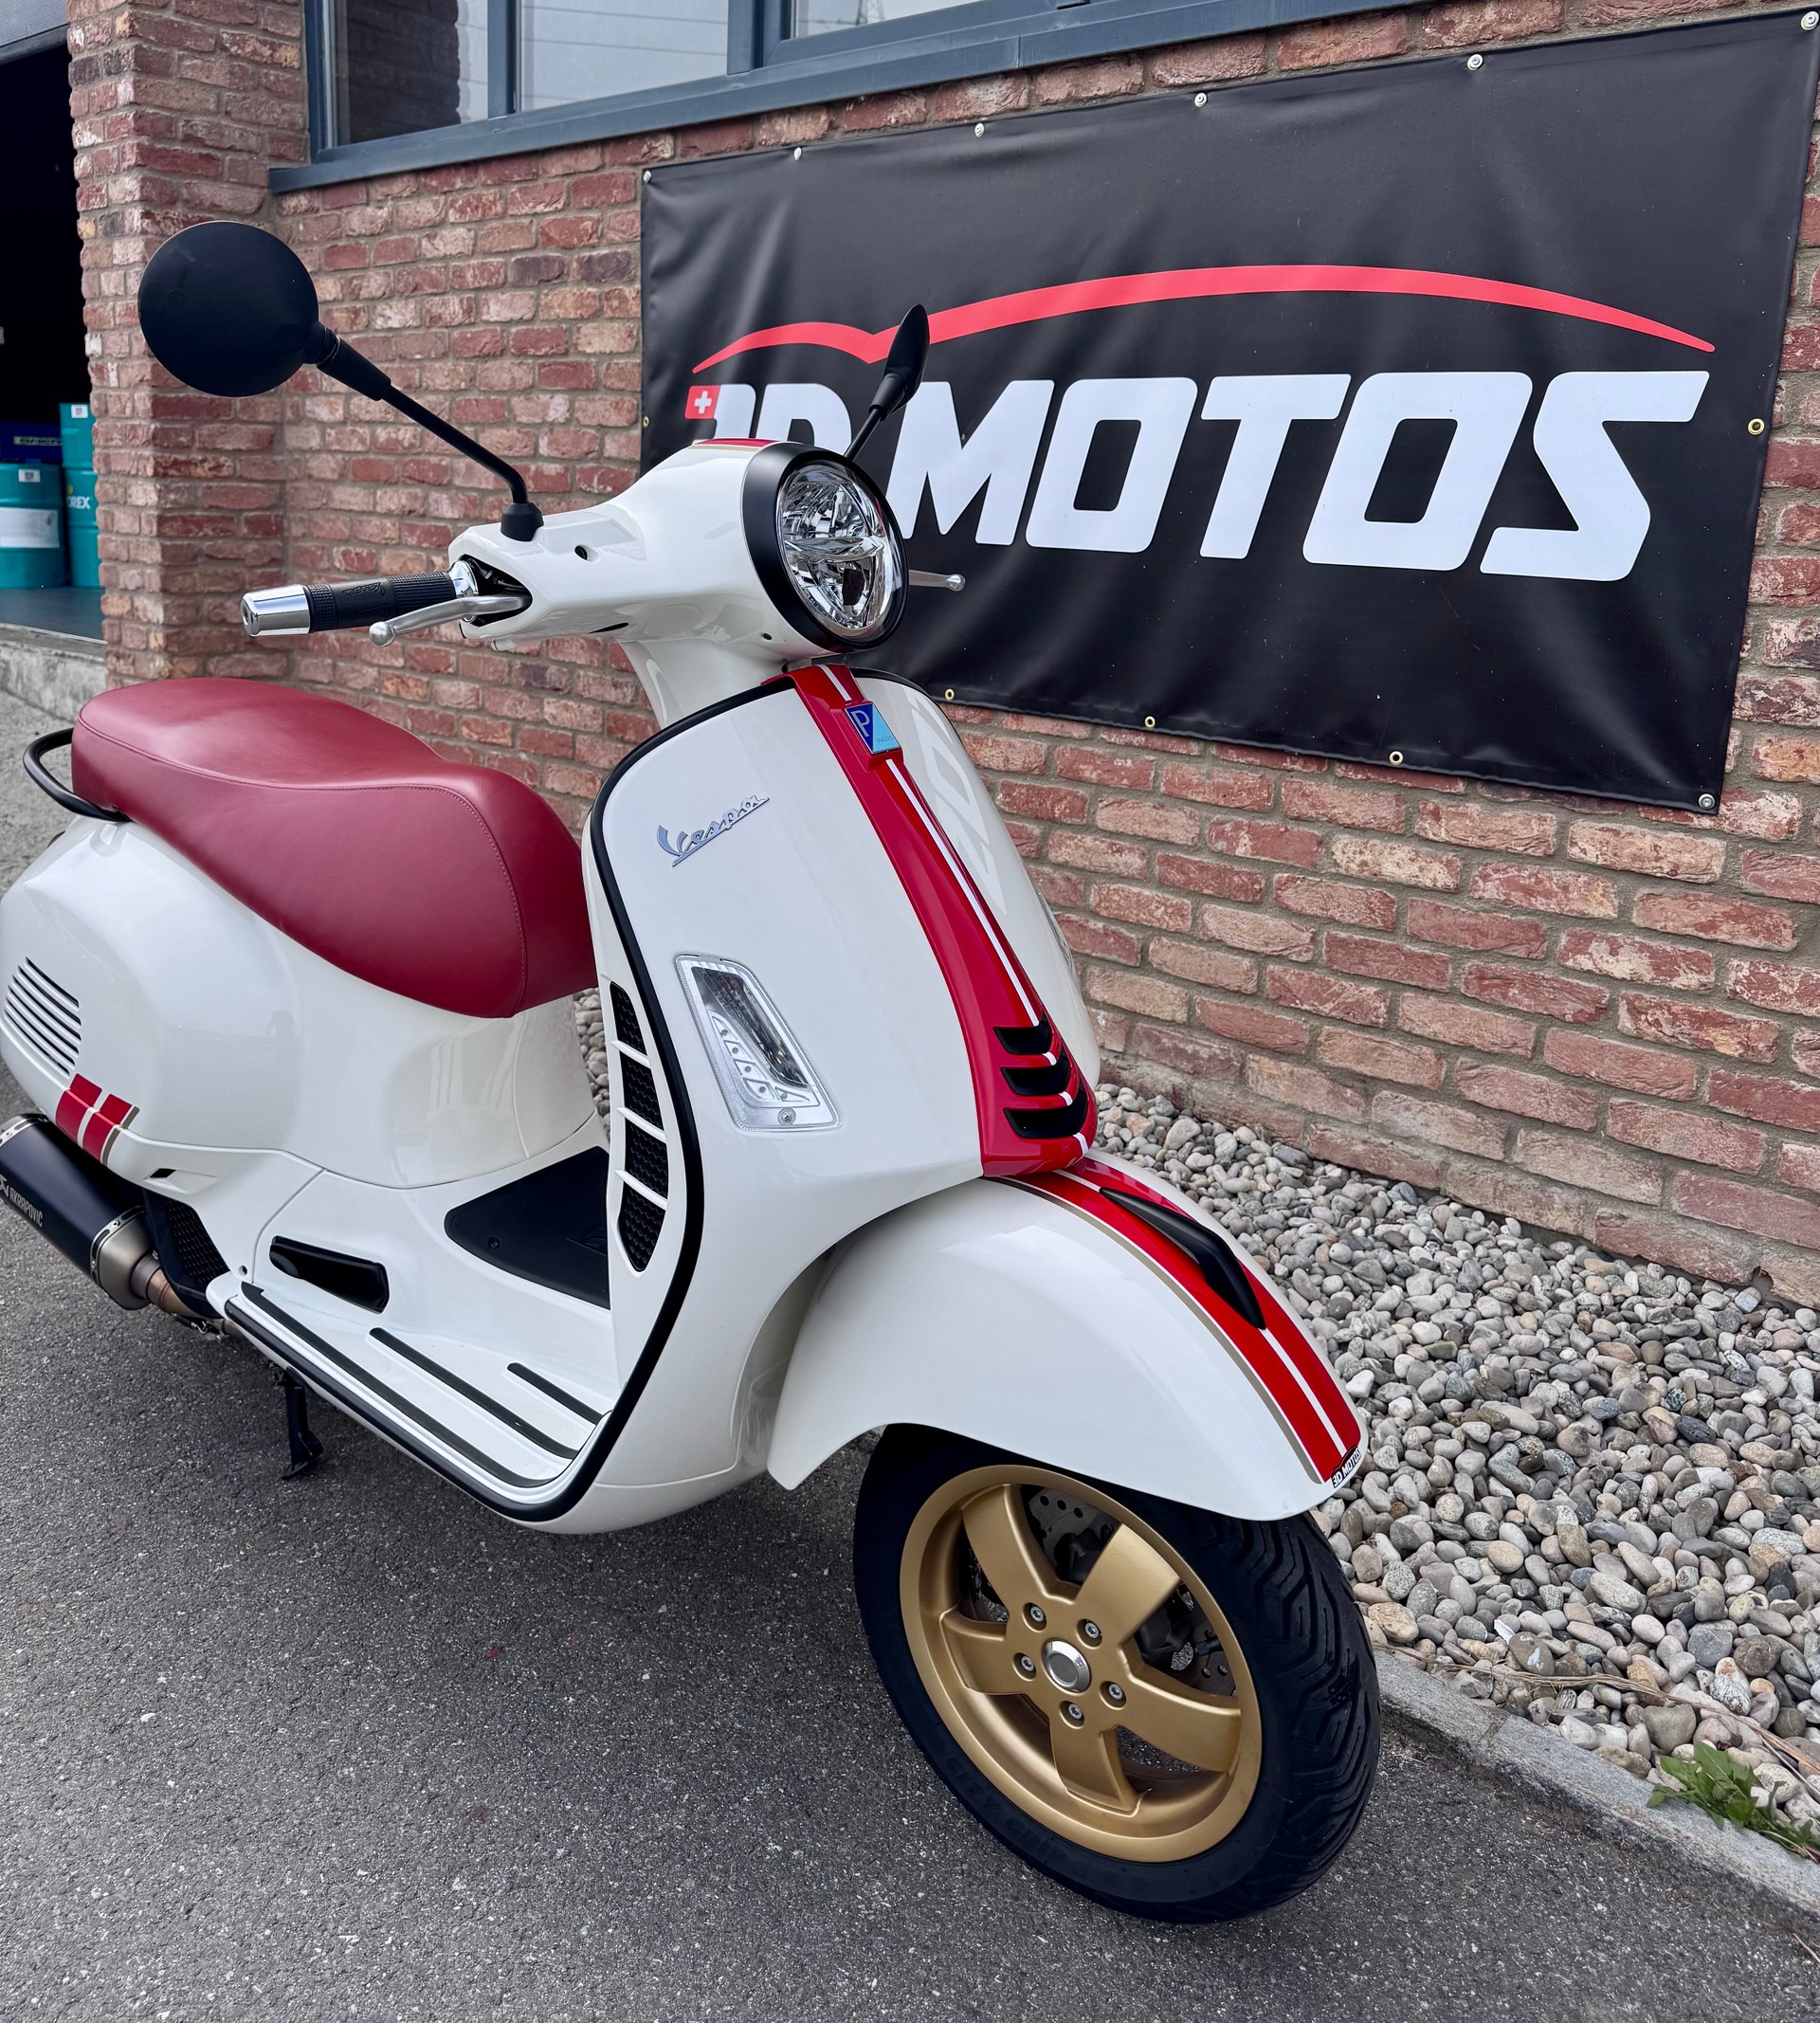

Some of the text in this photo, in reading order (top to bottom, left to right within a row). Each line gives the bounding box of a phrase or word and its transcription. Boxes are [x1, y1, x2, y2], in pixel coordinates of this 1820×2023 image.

[886, 371, 1710, 581] MOTOS
[656, 795, 770, 867] Vespa
[1332, 1448, 1361, 1487] 3D MOTOS
